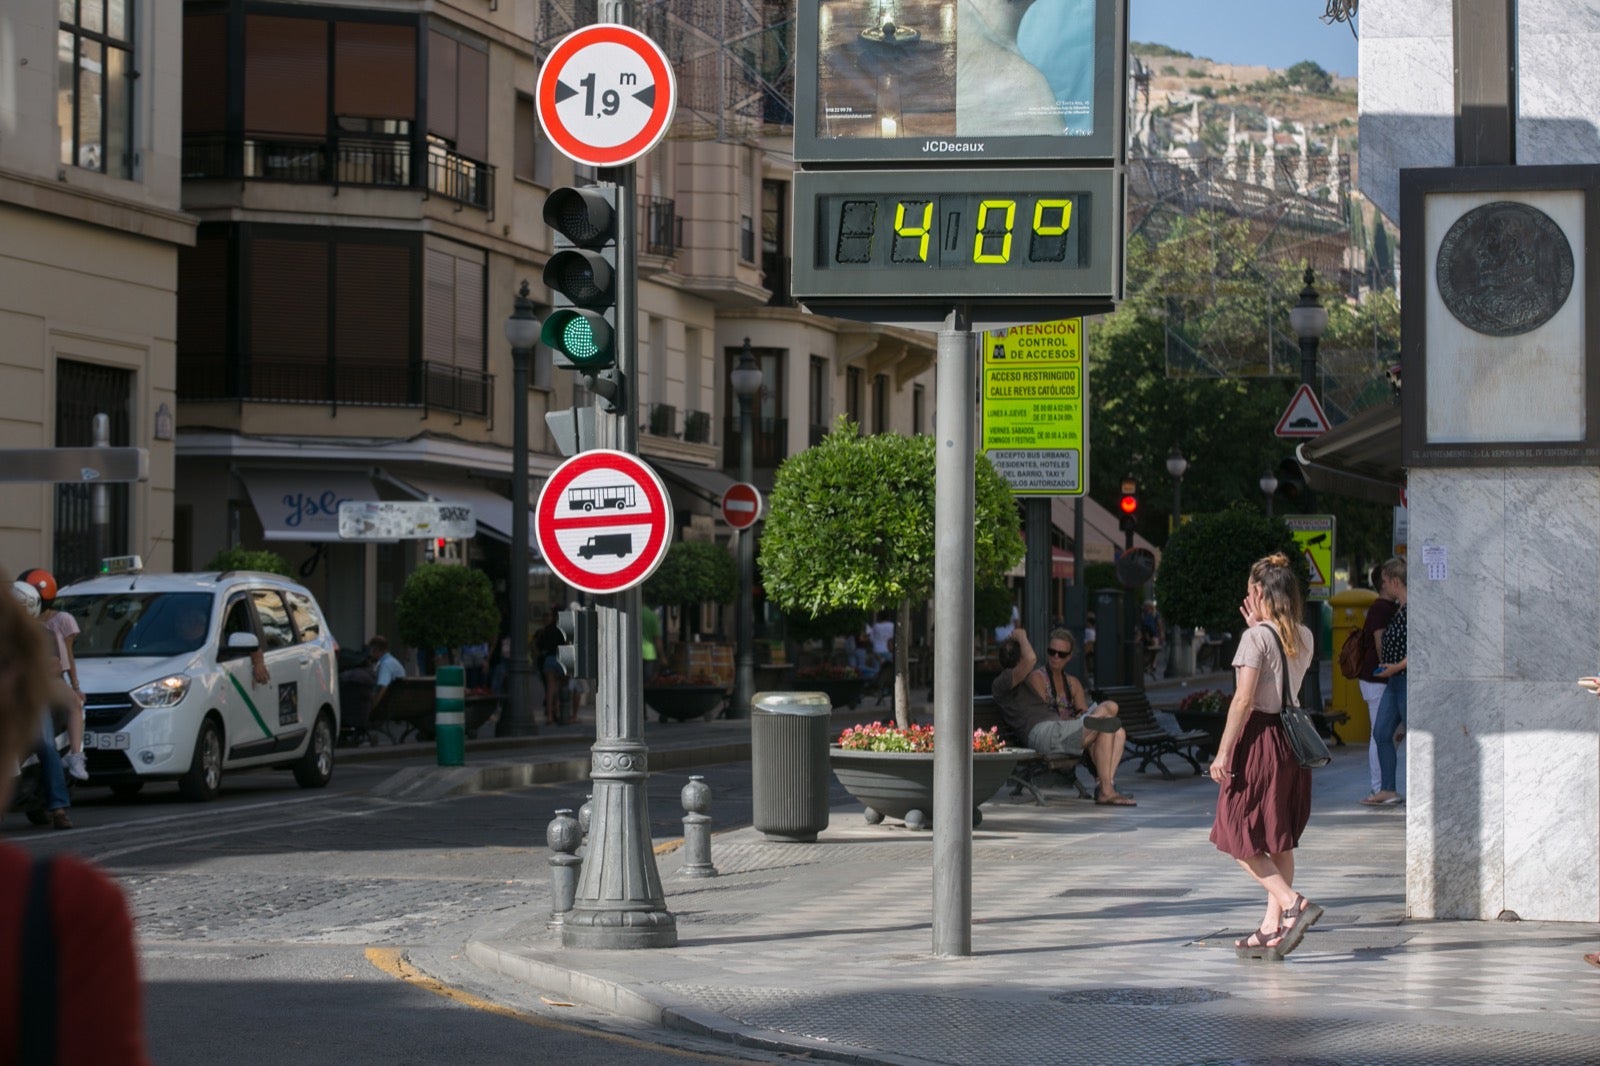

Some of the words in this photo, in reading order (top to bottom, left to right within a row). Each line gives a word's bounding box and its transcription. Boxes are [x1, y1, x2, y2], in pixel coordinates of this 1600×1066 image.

[579, 73, 620, 119] 1,9
[620, 72, 637, 85] m
[922, 140, 984, 152] JCDecaux
[1009, 322, 1076, 335] ATENCIÓN
[1018, 338, 1068, 348] CONTROL
[1010, 350, 1024, 360] DE
[1026, 350, 1076, 359] ACCESOS
[990, 372, 1020, 382] ACCESO
[1023, 371, 1076, 381] RESTRINGIDO
[990, 386, 1012, 396] CALLE
[1014, 386, 1036, 396] REYES
[1038, 384, 1076, 396] CATÓLICOS
